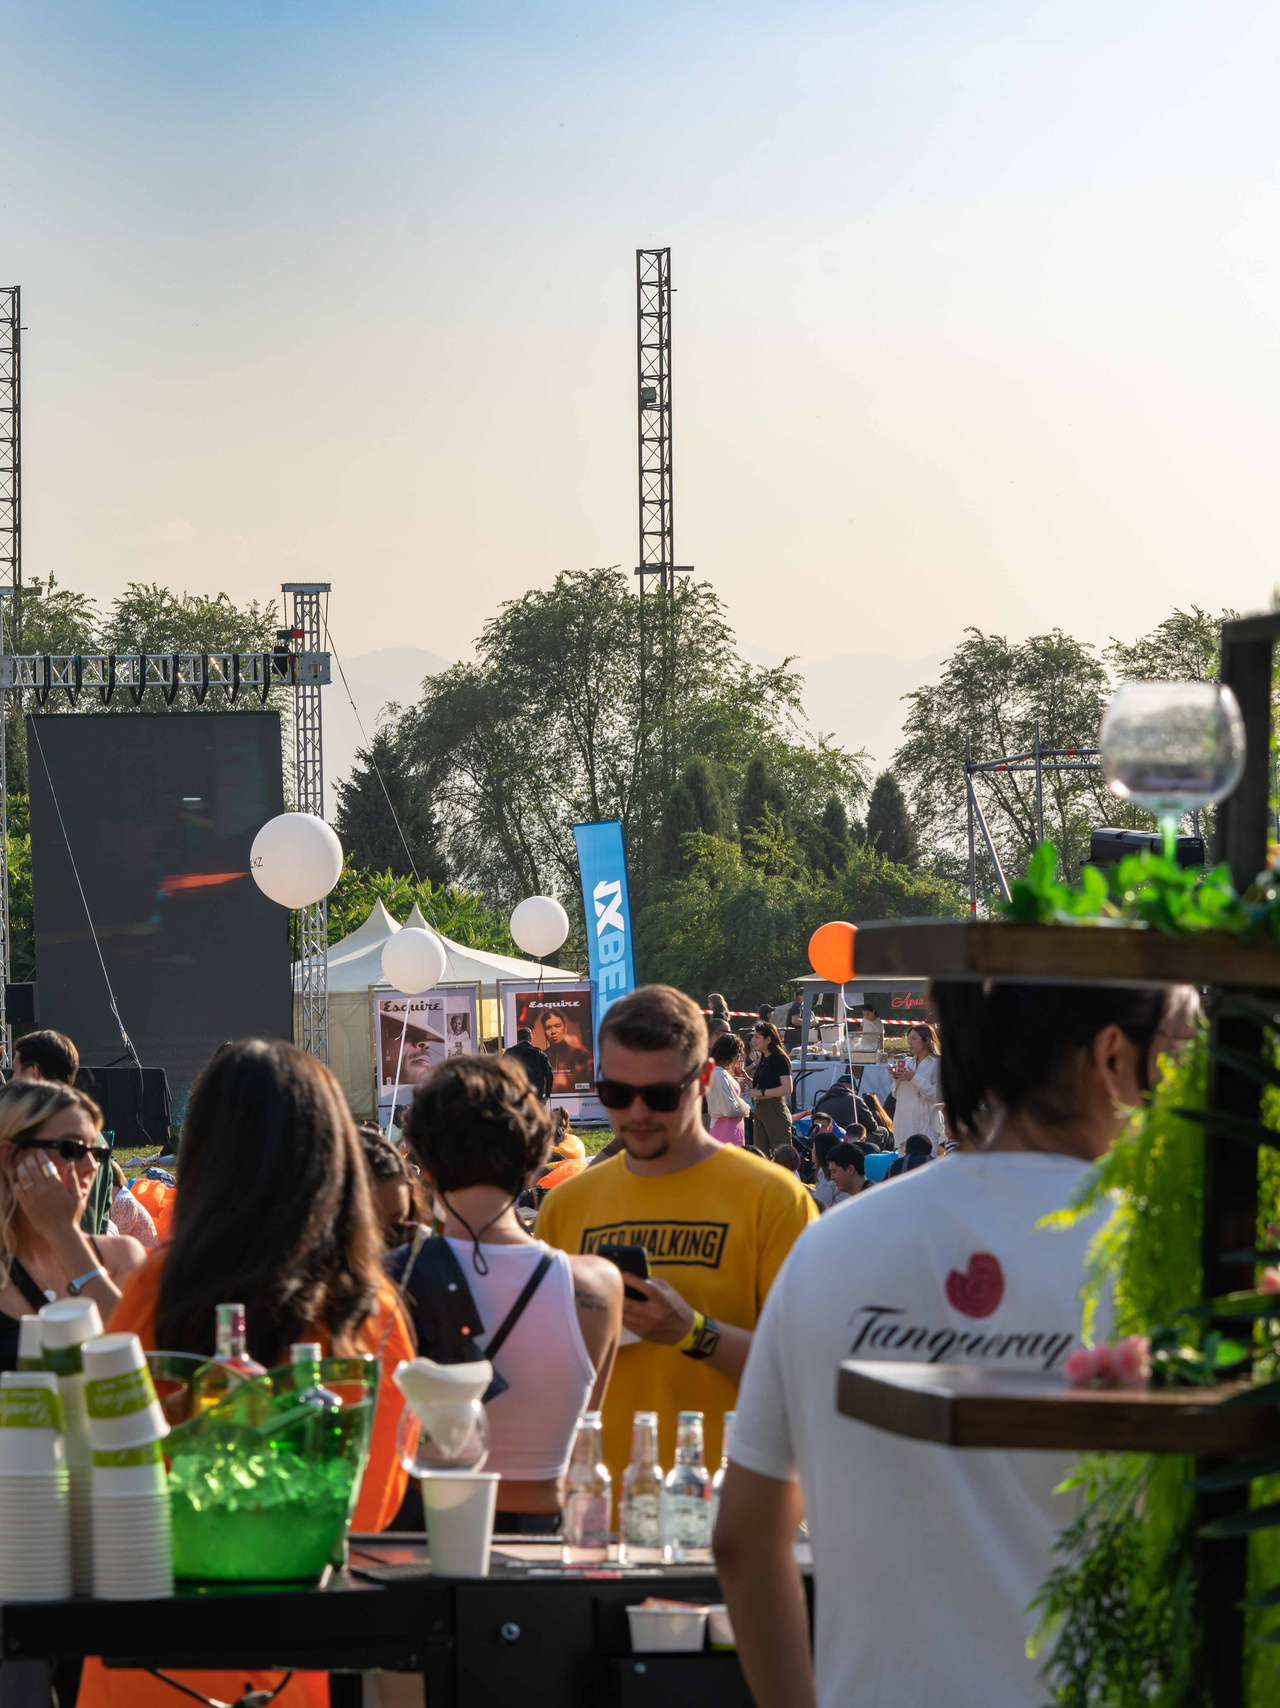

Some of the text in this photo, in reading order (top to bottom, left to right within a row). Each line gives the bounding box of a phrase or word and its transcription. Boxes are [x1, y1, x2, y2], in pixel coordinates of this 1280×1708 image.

[383, 1000, 442, 1014] Esquire
[528, 1000, 581, 1009] Esquire
[849, 1305, 1074, 1371] Tanqueray
